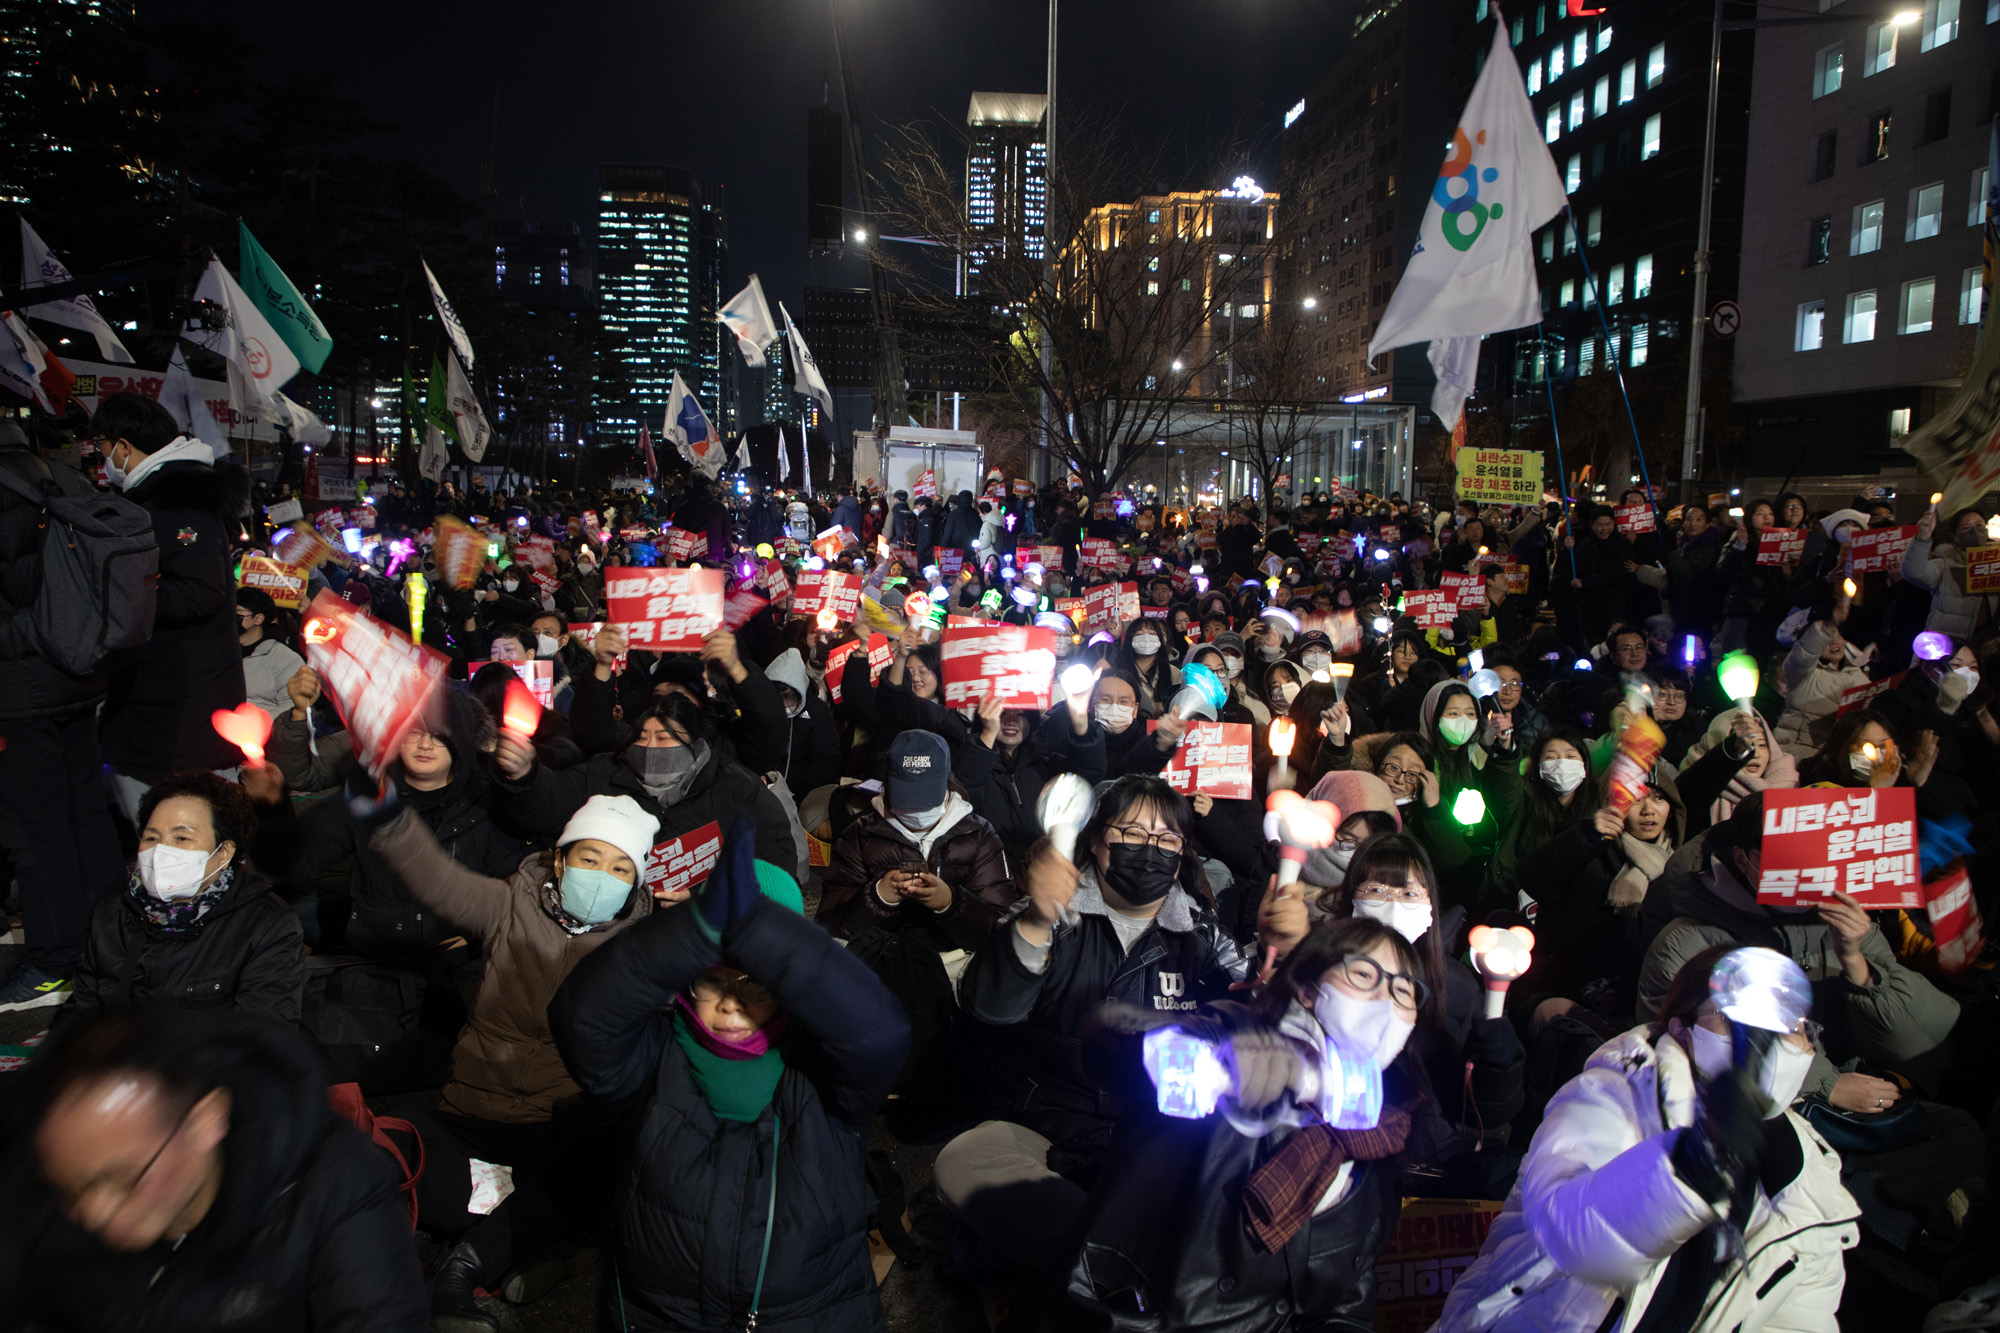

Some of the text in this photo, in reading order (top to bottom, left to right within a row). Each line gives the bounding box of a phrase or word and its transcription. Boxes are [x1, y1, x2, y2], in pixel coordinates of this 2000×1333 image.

[1476, 452, 1523, 465] 내란수괴
[1475, 465, 1523, 479] 윤석열을
[1462, 477, 1536, 492] 당장 체포하라
[1761, 529, 1798, 542] 내란수괴
[1852, 527, 1902, 548] 내란수괴
[1779, 539, 1806, 551] 윤석열
[1854, 558, 1882, 569] 즉각
[605, 571, 690, 599] 내란수괴
[797, 573, 847, 587] 내란수괴
[1440, 576, 1478, 587] 내란수괴
[341, 590, 352, 600] H
[818, 586, 860, 601] 윤석열
[1405, 592, 1445, 607] 내란수괴
[646, 593, 722, 620] 윤석열
[794, 598, 857, 614] 즉각 탄핵!
[1426, 603, 1457, 613] 윤석열
[1089, 610, 1107, 625] 즉각
[1840, 677, 1891, 706] 내란수괴
[1185, 744, 1250, 767] 윤석열
[1196, 765, 1250, 787] 탄핵!
[1763, 788, 1877, 836] 내란수괴
[1827, 820, 1914, 862] 윤석열
[644, 836, 721, 884] 윤석열
[1759, 853, 1916, 898] 즉각 탄핵!
[1158, 971, 1186, 998] W
[1153, 995, 1198, 1011] Wilson
